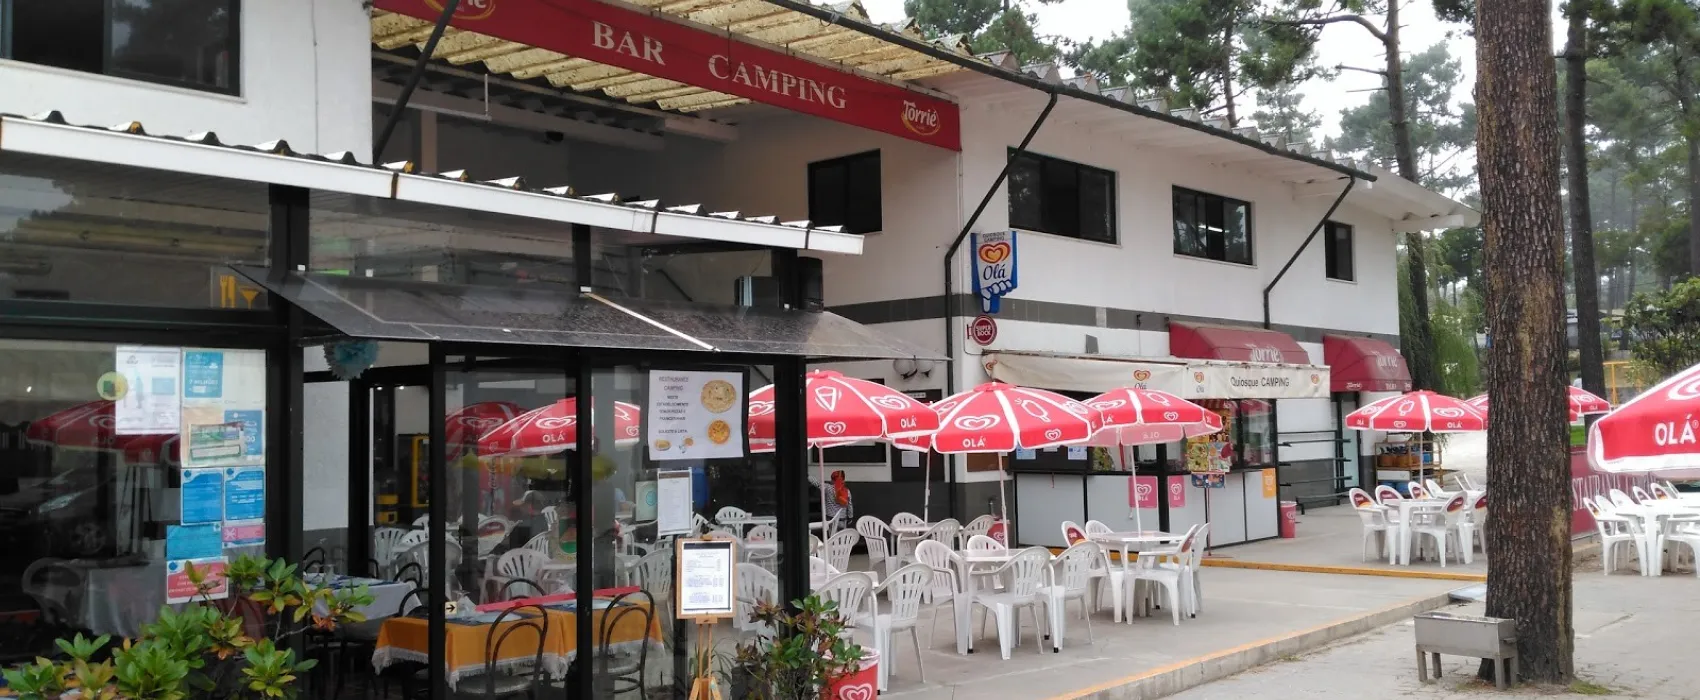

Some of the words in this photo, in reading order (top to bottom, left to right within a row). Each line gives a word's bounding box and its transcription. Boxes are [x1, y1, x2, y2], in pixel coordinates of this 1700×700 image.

[592, 21, 666, 66] BAR
[708, 54, 846, 109] CAMPING
[983, 264, 1006, 280] Olá
[1231, 376, 1258, 389] Quiosque
[1261, 377, 1289, 387] CAMPING
[900, 416, 916, 428] OLÁ
[1655, 414, 1697, 446] OLÁ
[542, 431, 564, 443] OLÁ
[963, 436, 985, 448] OLÁ
